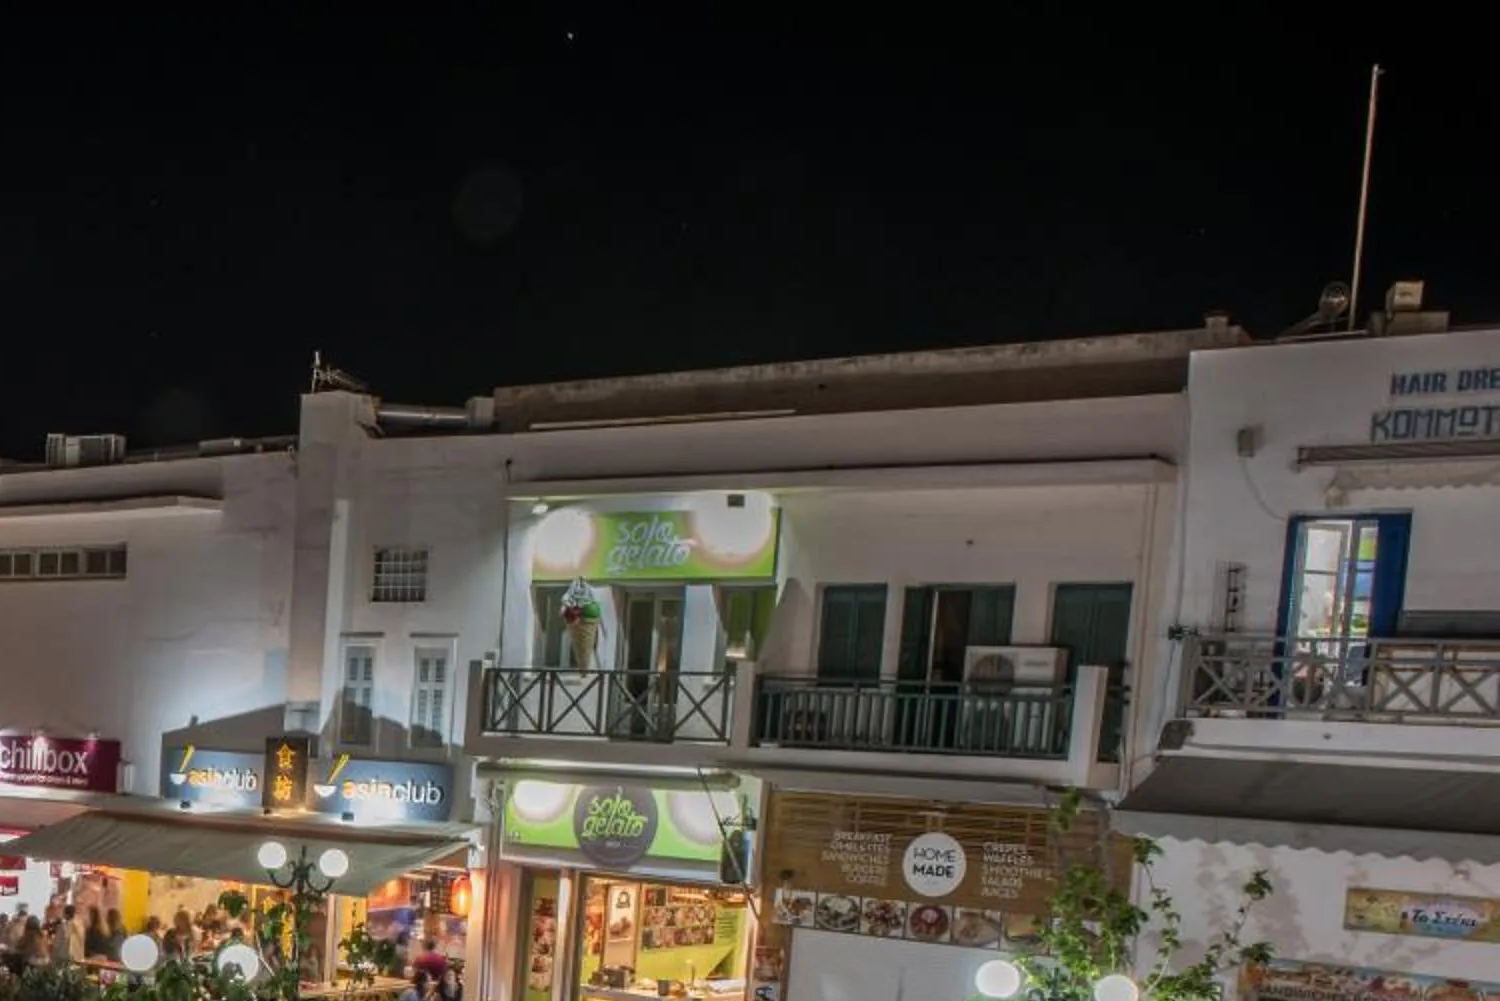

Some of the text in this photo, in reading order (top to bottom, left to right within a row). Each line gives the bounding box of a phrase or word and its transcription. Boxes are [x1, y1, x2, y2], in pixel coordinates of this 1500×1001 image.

[1389, 372, 1448, 395] HAIR
[616, 516, 675, 543] solo
[606, 537, 692, 575] gelato
[0, 739, 89, 775] chillbox
[186, 763, 258, 792] asiaclub
[342, 775, 442, 805] asiaclub
[589, 787, 636, 815] solo
[581, 811, 649, 840] gelato
[833, 830, 893, 843] BREAKFAST
[912, 846, 957, 864] HOME
[912, 864, 955, 878] MADE
